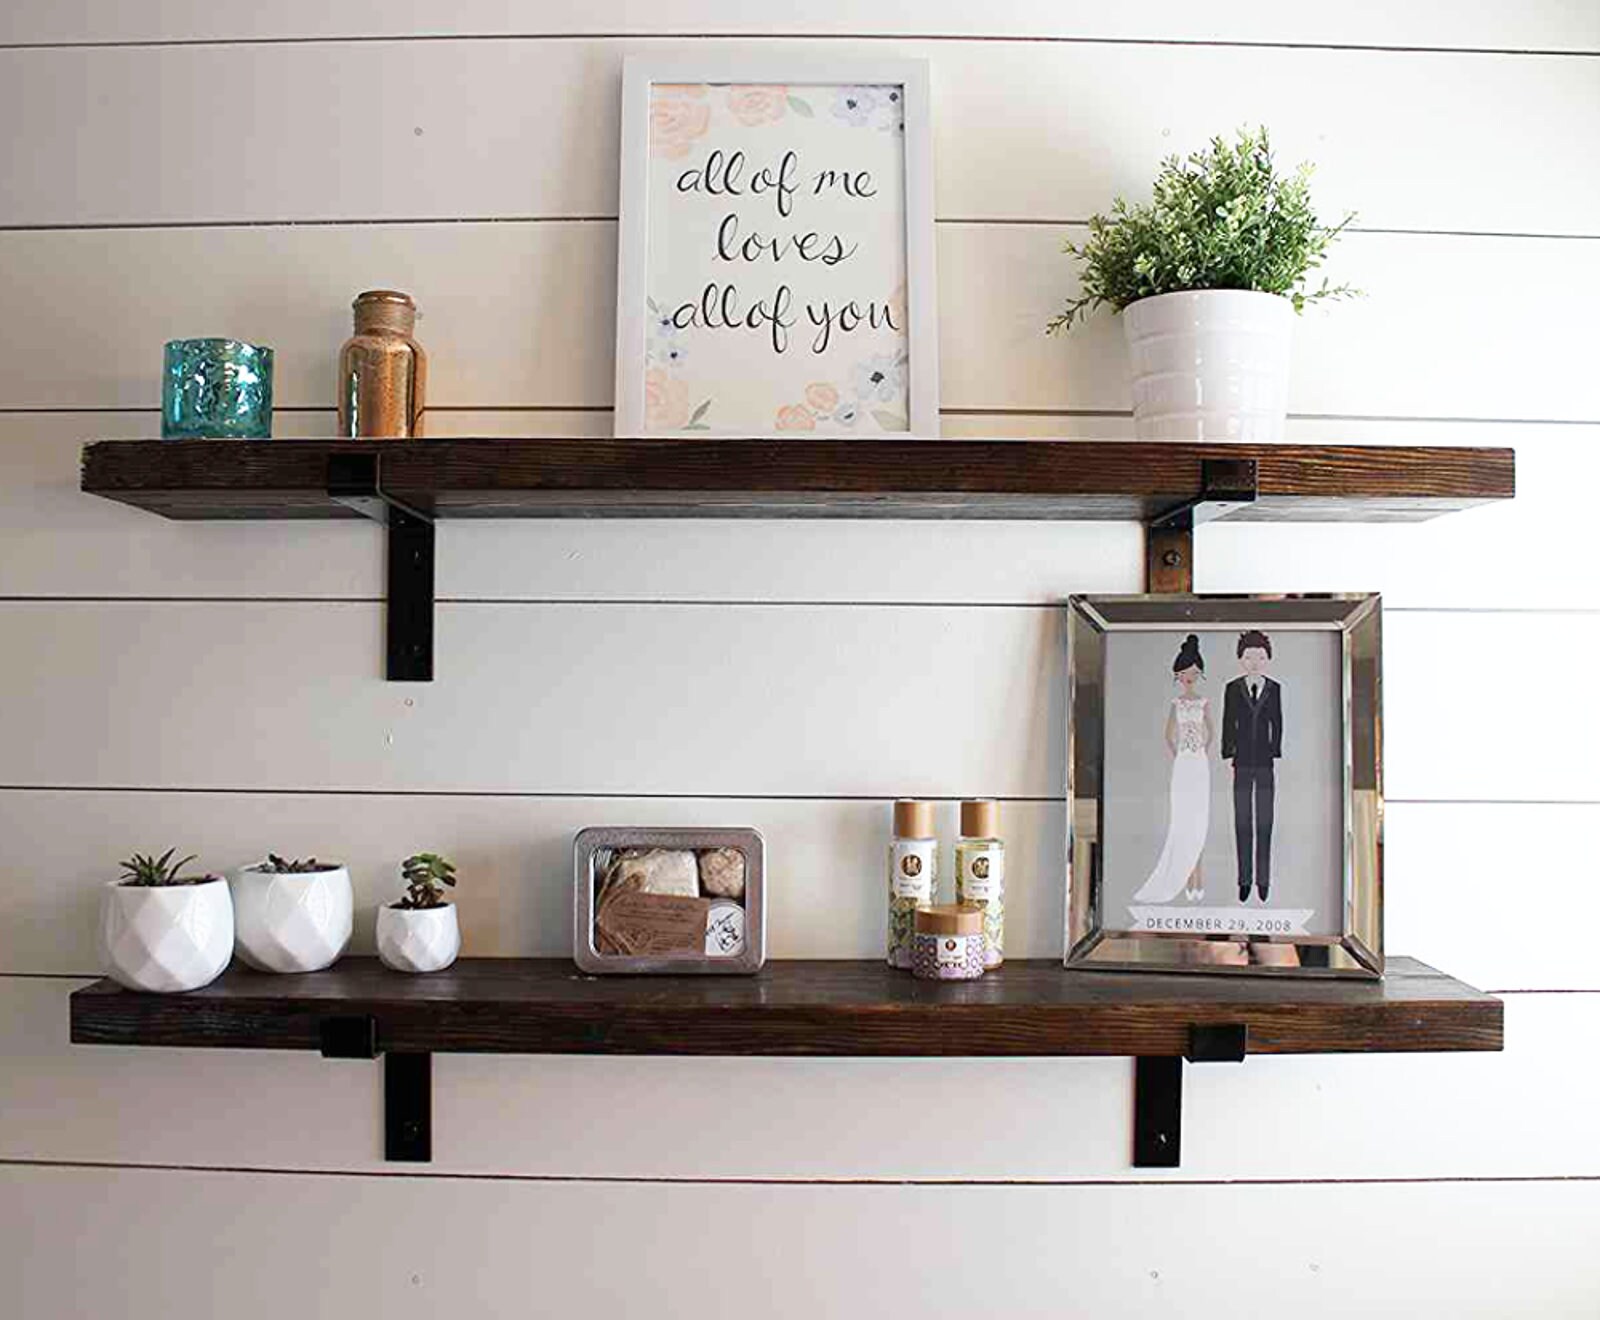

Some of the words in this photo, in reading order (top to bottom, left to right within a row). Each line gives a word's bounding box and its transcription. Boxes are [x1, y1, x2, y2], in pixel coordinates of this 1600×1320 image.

[676, 150, 744, 195] all
[750, 151, 800, 217] of
[813, 170, 877, 197] me
[712, 213, 858, 265] loves
[672, 283, 742, 328] all
[746, 285, 797, 353] of
[806, 302, 901, 353] you
[1145, 917, 1222, 930] DECEMBER
[1228, 918, 1250, 932] 29,
[1256, 919, 1292, 931] 2008
